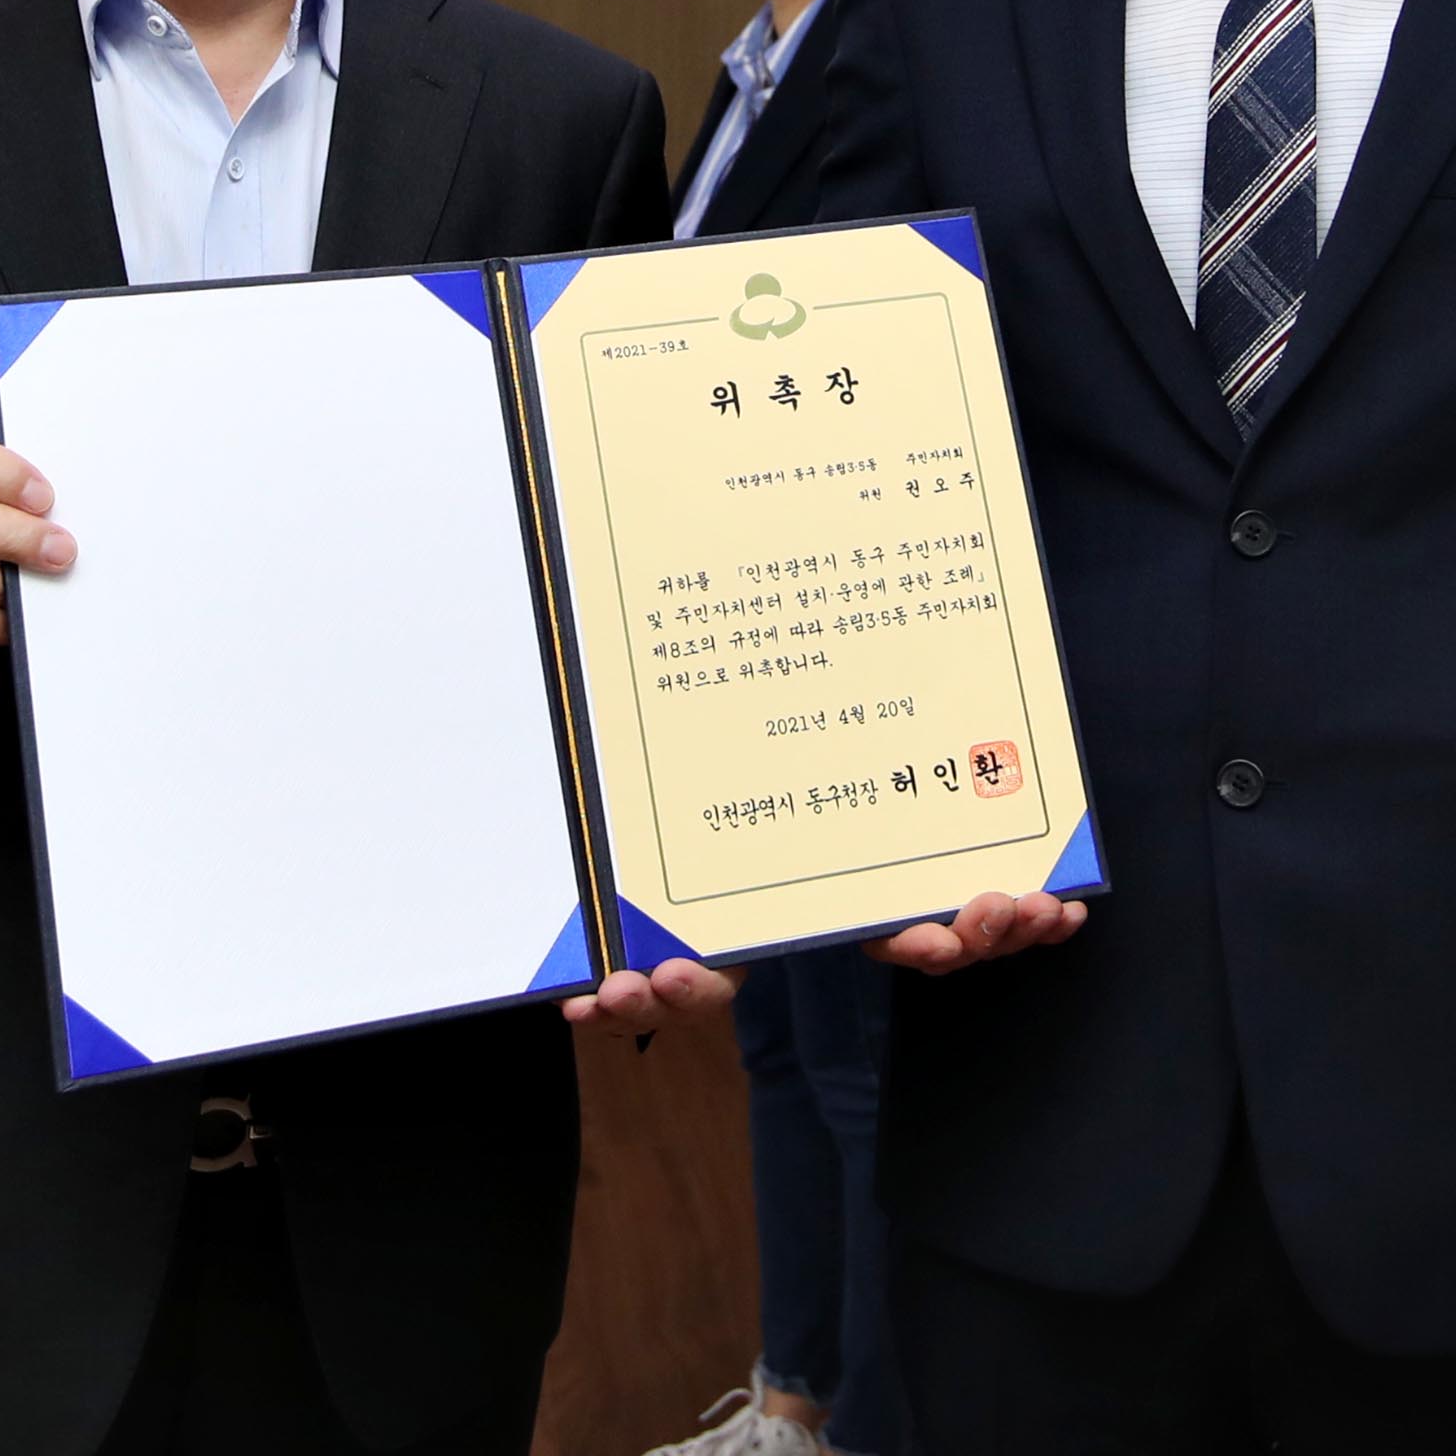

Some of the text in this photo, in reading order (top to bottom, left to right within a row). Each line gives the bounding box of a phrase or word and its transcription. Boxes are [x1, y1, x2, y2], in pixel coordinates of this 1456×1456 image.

[601, 339, 689, 360] 제2021-39호
[725, 470, 786, 491] 인천광역시
[793, 466, 817, 482] 동구
[905, 446, 964, 465] 주민자치회
[859, 487, 882, 501] 위원
[657, 571, 711, 596] 귀하를
[850, 546, 885, 570] 동구
[897, 531, 985, 562] 주민자치회
[646, 610, 663, 631] 및
[675, 592, 783, 627] 주민자치센터
[898, 571, 934, 594] 관한
[652, 634, 717, 662] 제8조의
[729, 625, 779, 649] 규정에
[790, 618, 825, 639] 따라
[917, 592, 998, 621] 주민자치회
[657, 650, 834, 693] 위원으로 위촉합니다.
[766, 696, 916, 737] 2021년 4월 20일
[702, 791, 796, 832] 인천광역시
[805, 778, 879, 815] 동구청장
